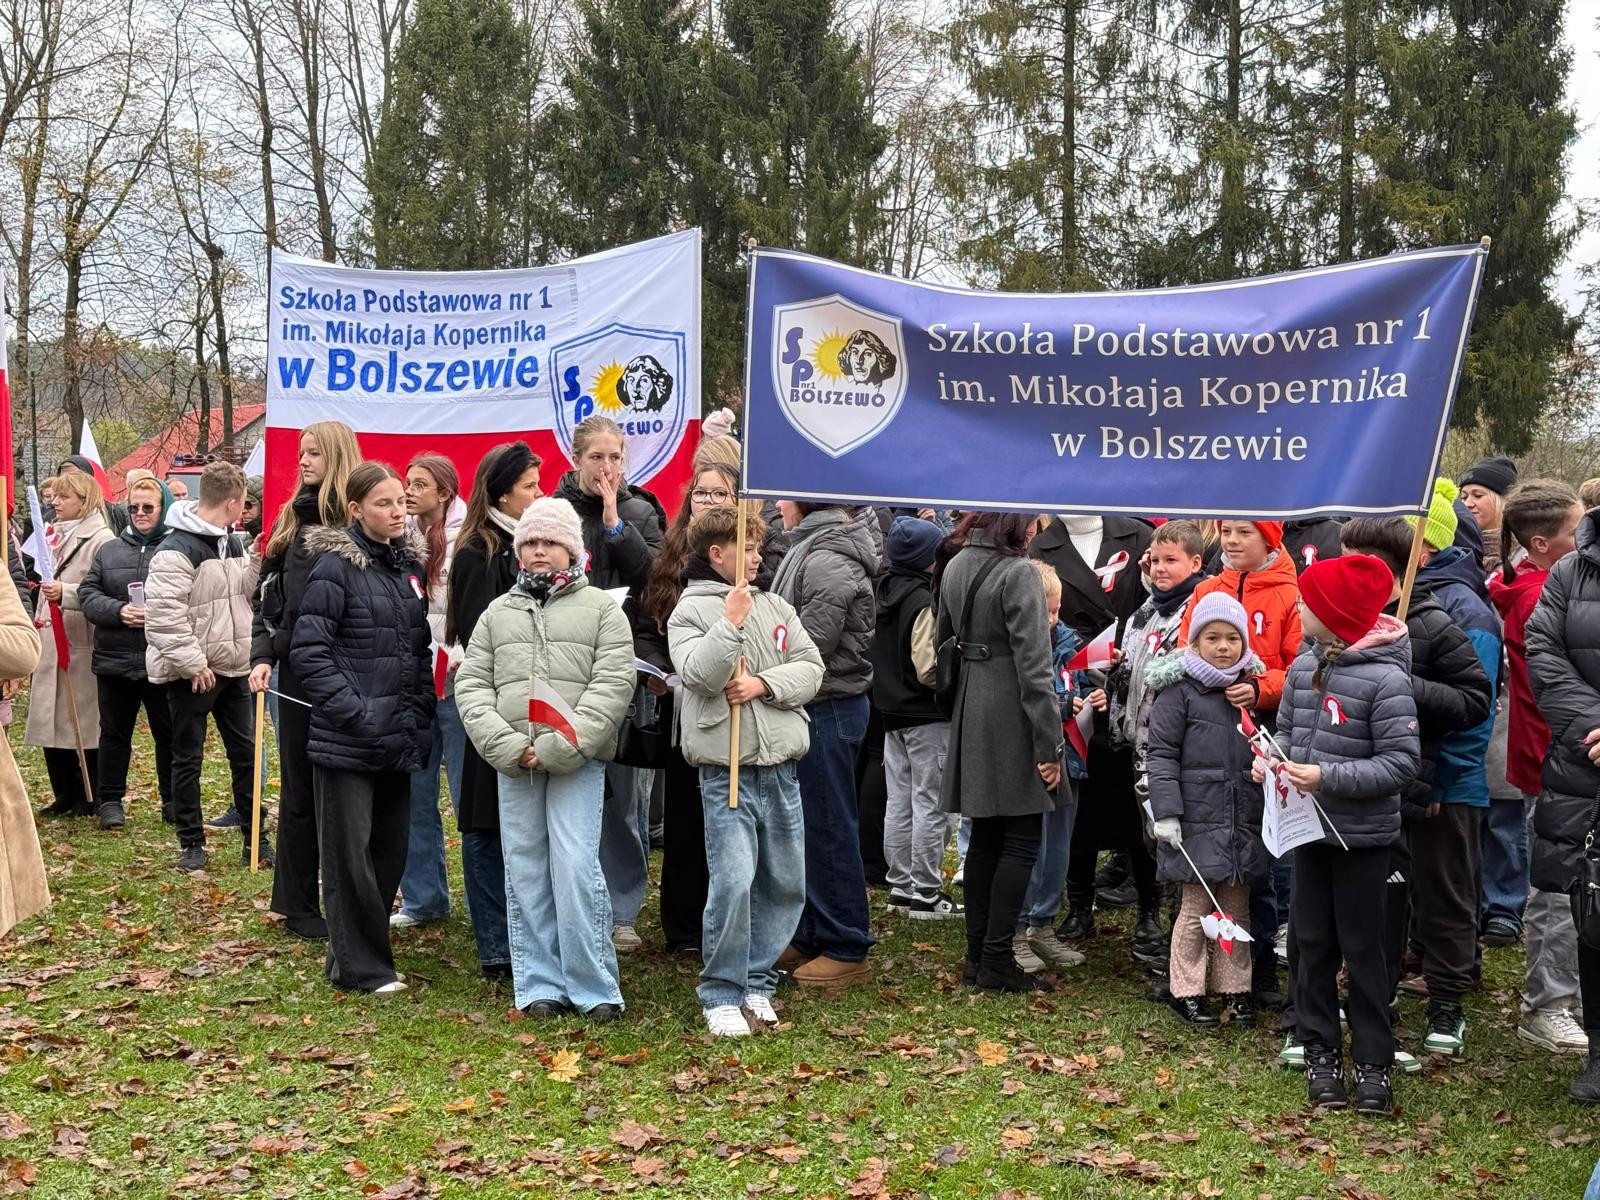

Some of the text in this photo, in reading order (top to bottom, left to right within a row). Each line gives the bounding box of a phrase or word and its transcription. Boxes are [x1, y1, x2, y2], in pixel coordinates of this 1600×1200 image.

[279, 285, 553, 313] Szkoła Podstawowa nr 1
[282, 318, 546, 351] im. Mikołaja Kopernika
[927, 306, 1432, 357] Szkoła Podstawowa nr 1
[278, 348, 540, 393] w Bolszewie
[789, 389, 886, 408] BOLSZEWO
[938, 366, 1408, 417] im. Mikołaja Kopernika
[1051, 427, 1309, 462] w Bolszewie
